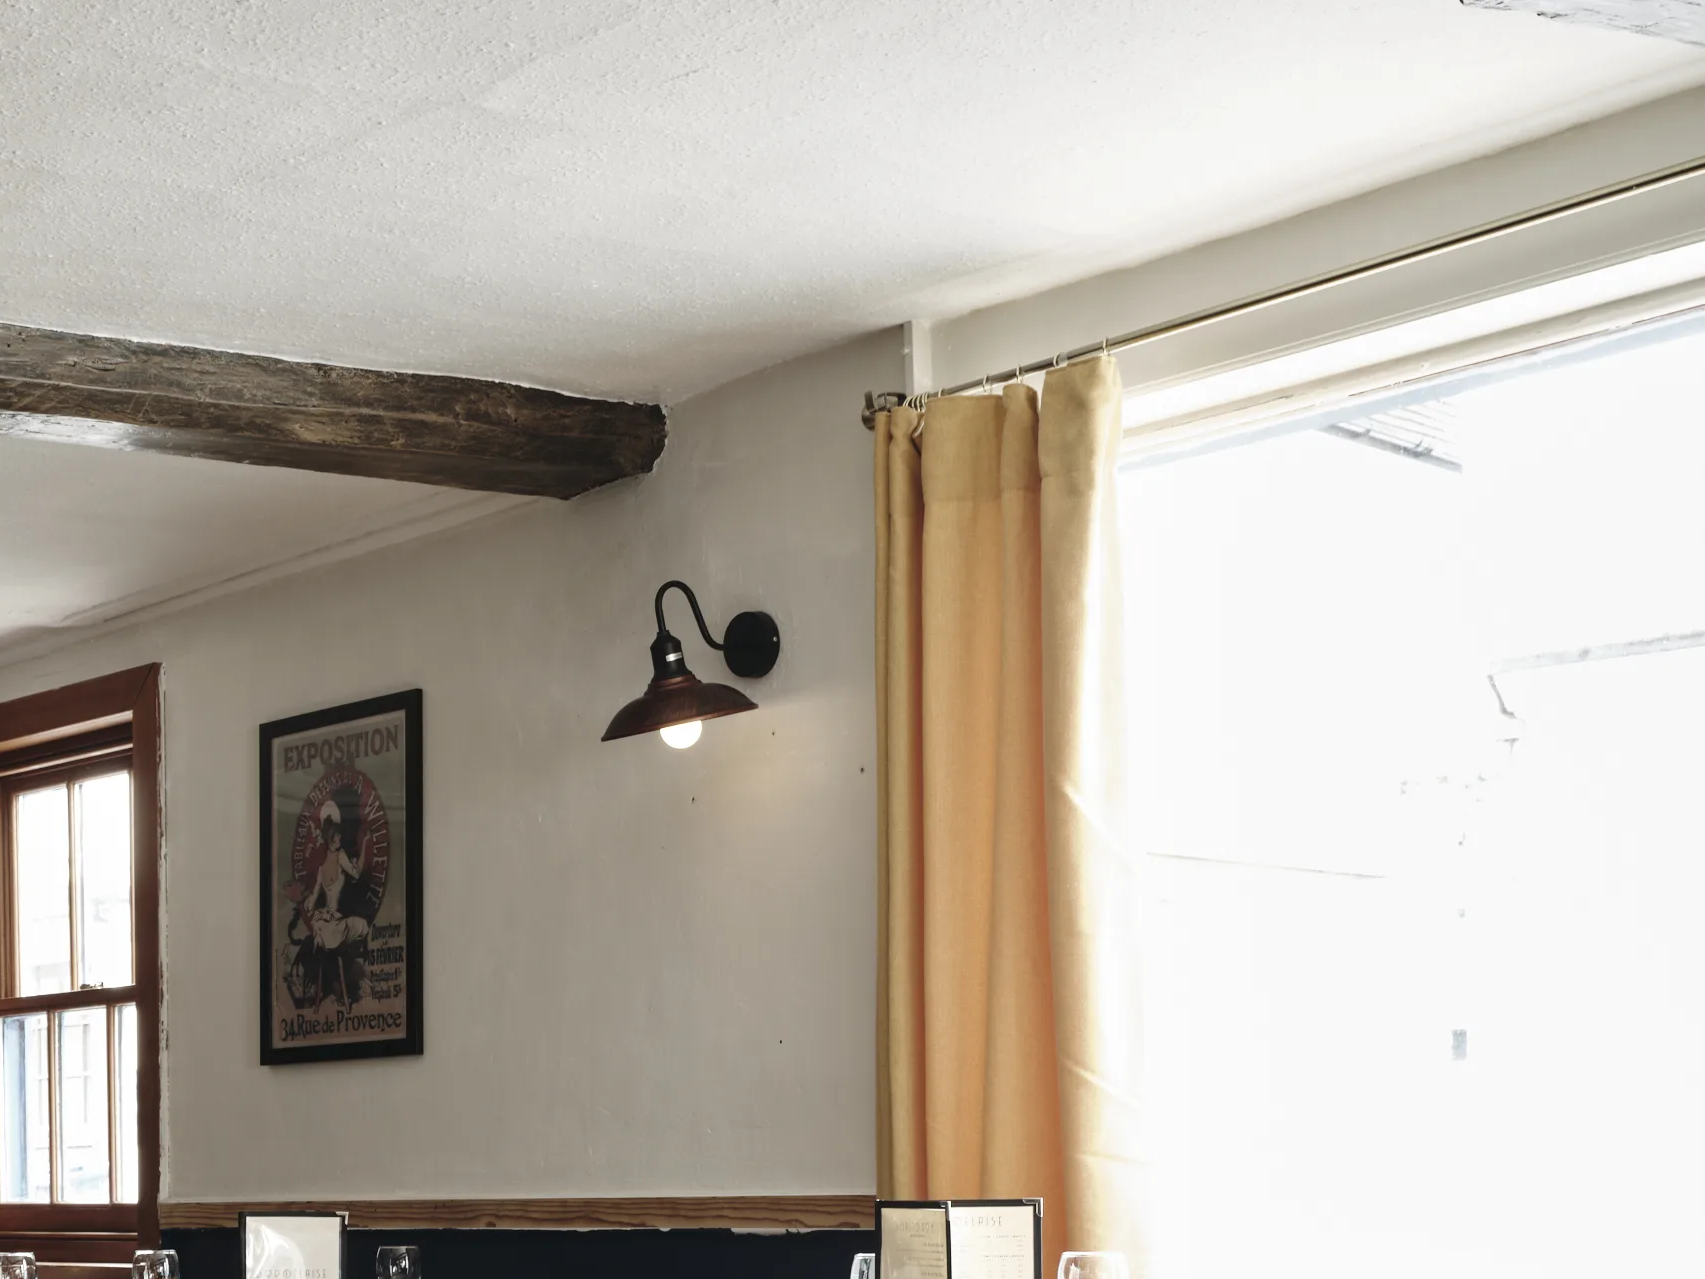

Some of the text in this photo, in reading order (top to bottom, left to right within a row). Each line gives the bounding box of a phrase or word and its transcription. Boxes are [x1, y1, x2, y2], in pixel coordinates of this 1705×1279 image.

[283, 725, 399, 773] EXPOSITION
[364, 789, 388, 908] WILLETTE
[322, 1015, 335, 1034] de
[336, 1010, 402, 1033] Provence
